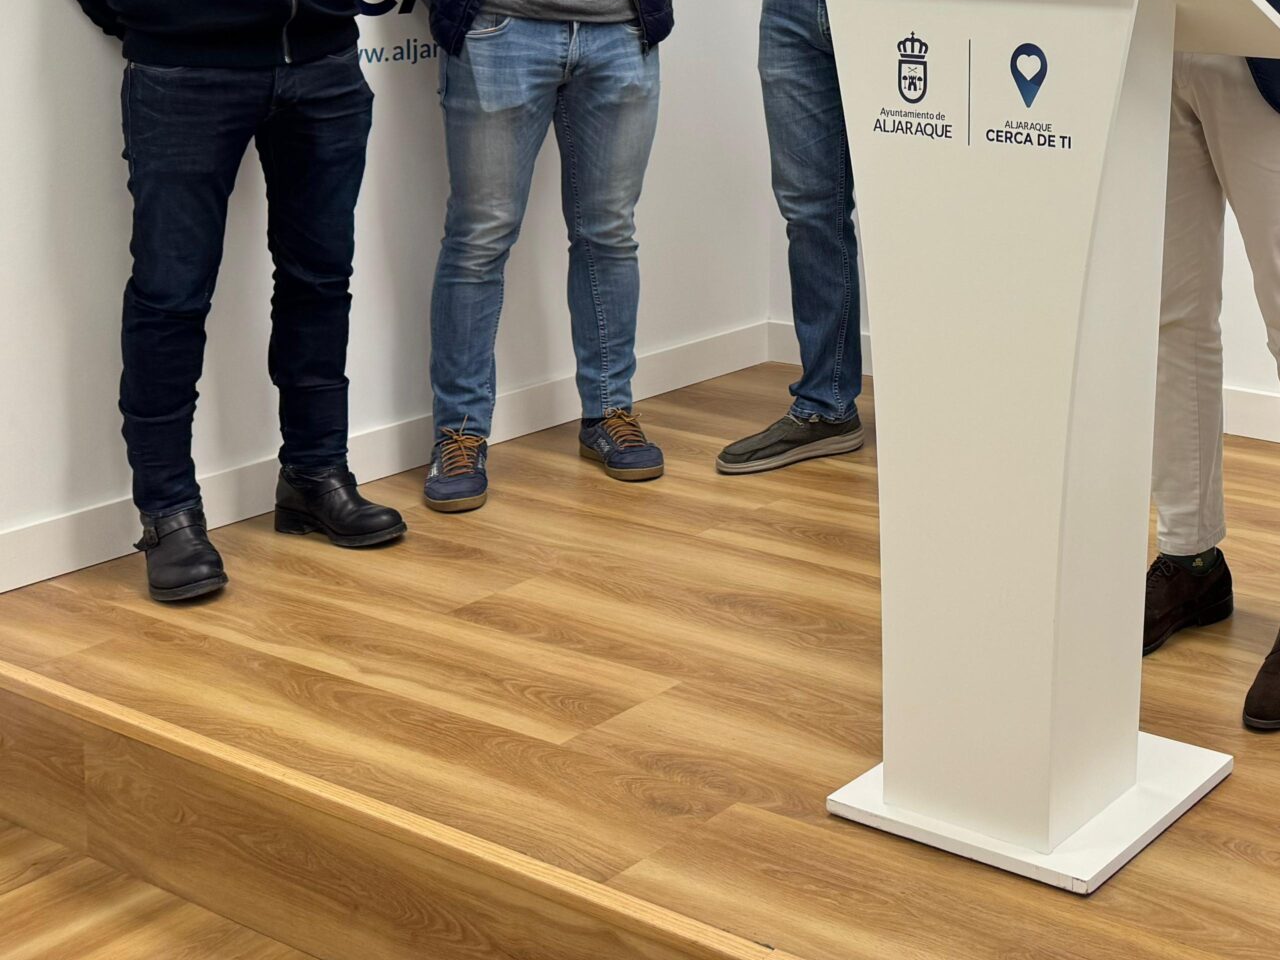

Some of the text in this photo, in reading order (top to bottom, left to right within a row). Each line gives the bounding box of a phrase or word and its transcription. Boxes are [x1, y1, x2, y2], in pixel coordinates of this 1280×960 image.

[880, 107, 945, 121] Ayuntamiento de
[873, 119, 952, 139] ALJARAQUE
[1004, 120, 1052, 132] ALJARAQUE
[986, 129, 1072, 149] CERCA DE TI
